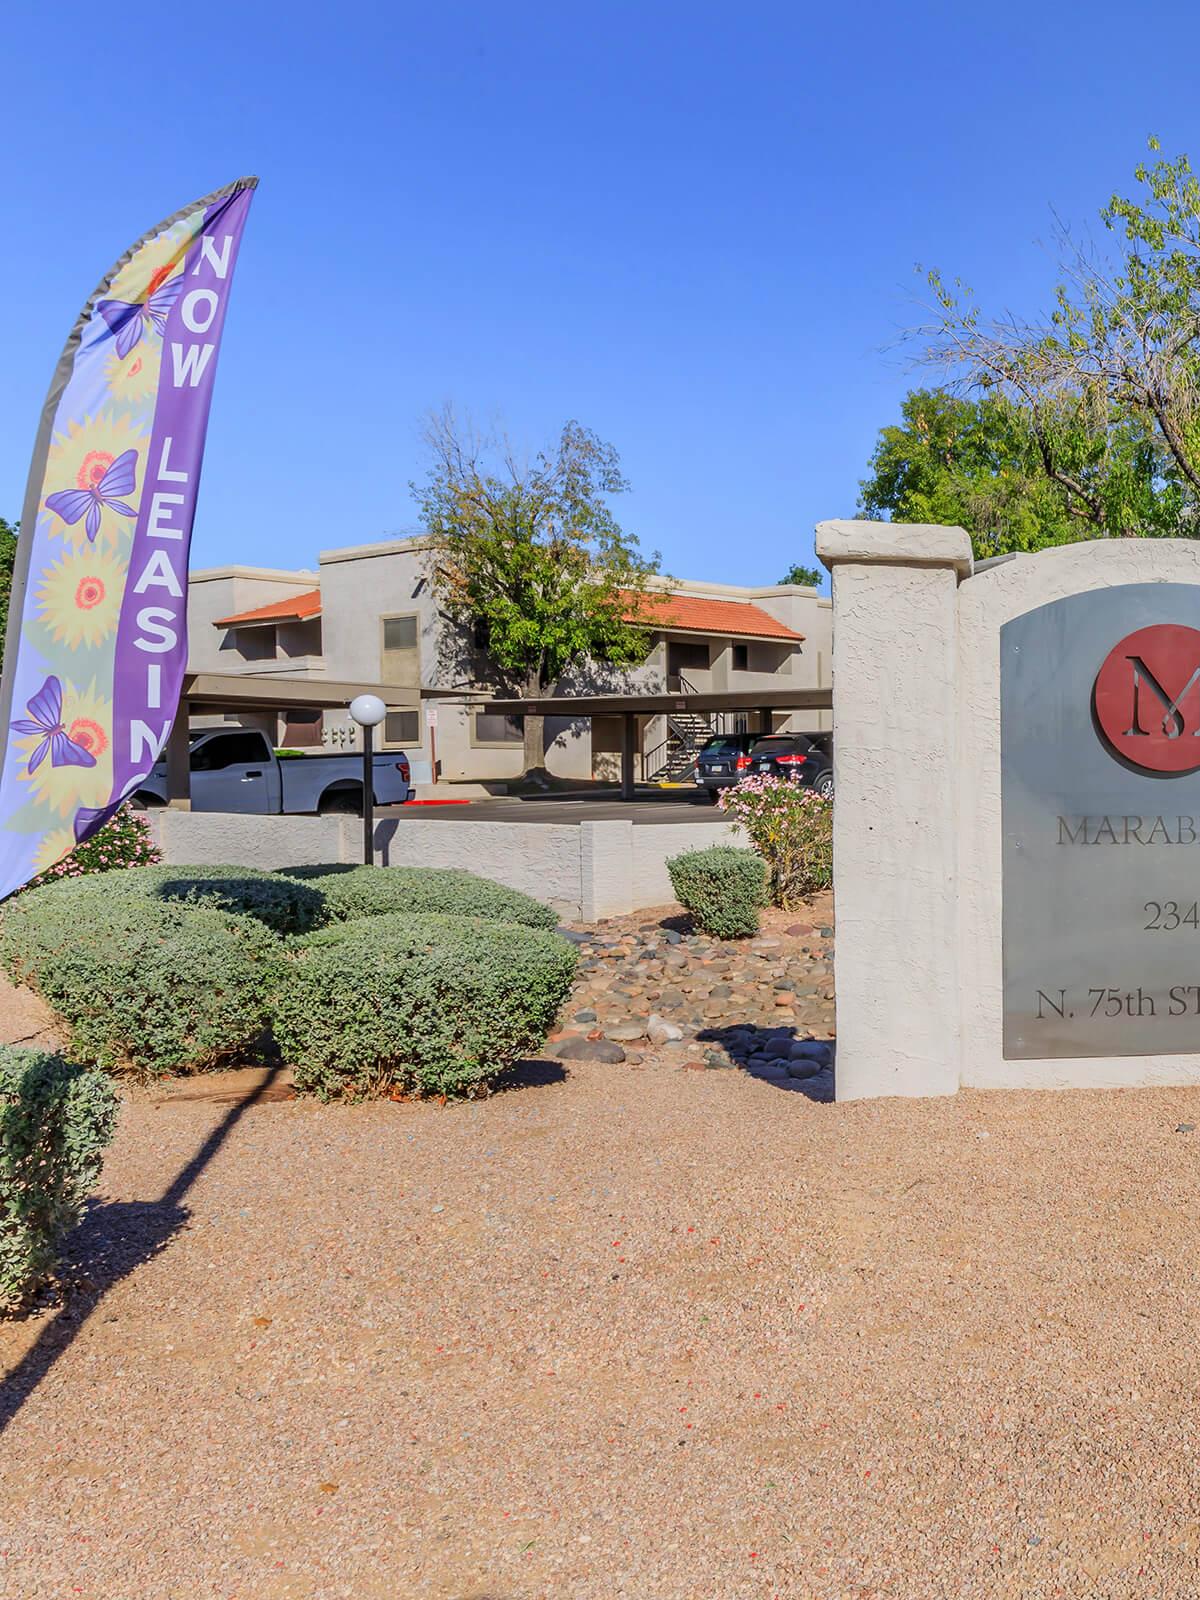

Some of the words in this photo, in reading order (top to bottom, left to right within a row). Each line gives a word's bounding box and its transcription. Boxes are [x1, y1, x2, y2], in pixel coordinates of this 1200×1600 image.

[171, 235, 232, 388] NOW
[1142, 901, 1200, 931] 234
[1034, 989, 1074, 1019] N.
[1087, 987, 1156, 1017] 75th
